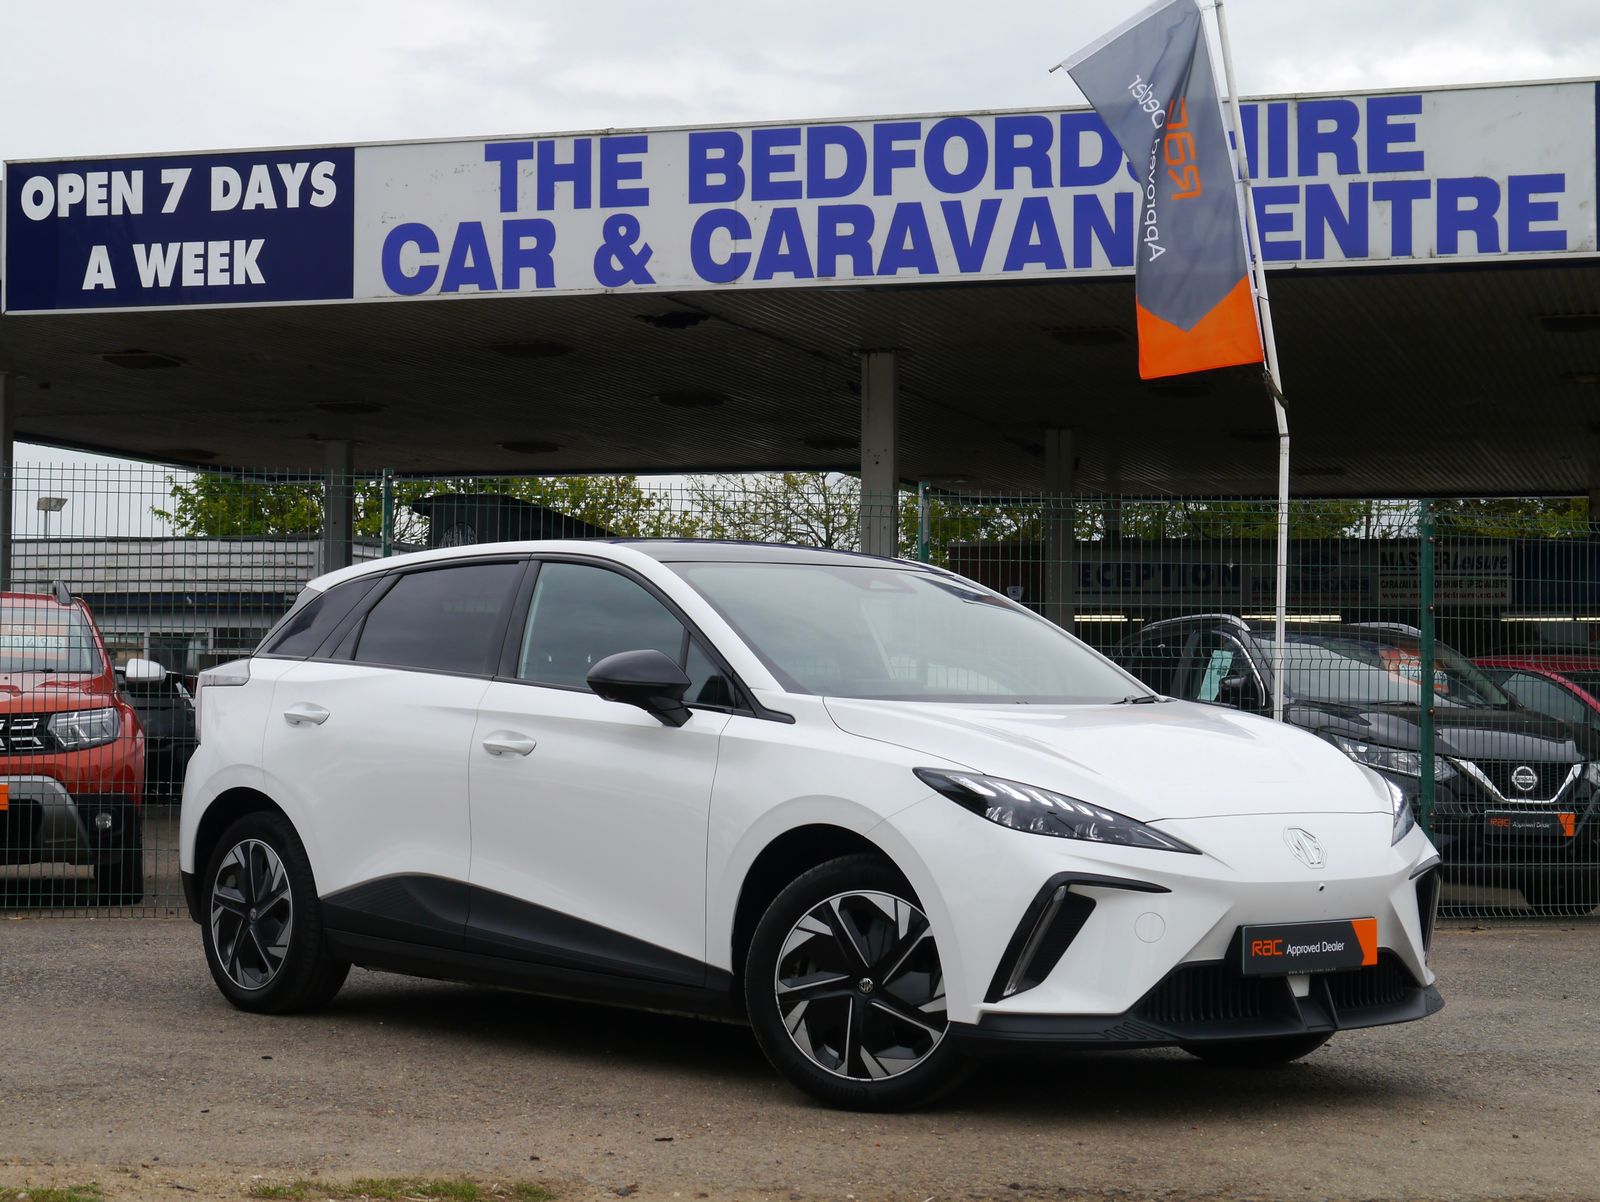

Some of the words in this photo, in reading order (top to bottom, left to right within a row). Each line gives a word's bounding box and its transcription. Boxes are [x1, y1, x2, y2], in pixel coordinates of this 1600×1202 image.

[485, 136, 649, 212] THE
[688, 95, 1425, 204] BEDFORDIRE
[20, 171, 144, 221] OPEN
[161, 168, 192, 214] 7
[210, 161, 337, 212] DAYS
[381, 219, 556, 295] CAR
[594, 214, 655, 287] &
[691, 193, 1134, 283] CARAVAN
[1247, 173, 1567, 262] ENTRE
[82, 246, 116, 290] A
[132, 238, 266, 288] WEEK
[1078, 563, 1241, 588] ECEPTION
[1380, 551, 1450, 571] MASER
[1286, 942, 1321, 957] Approved
[1322, 941, 1345, 952] Dealer
